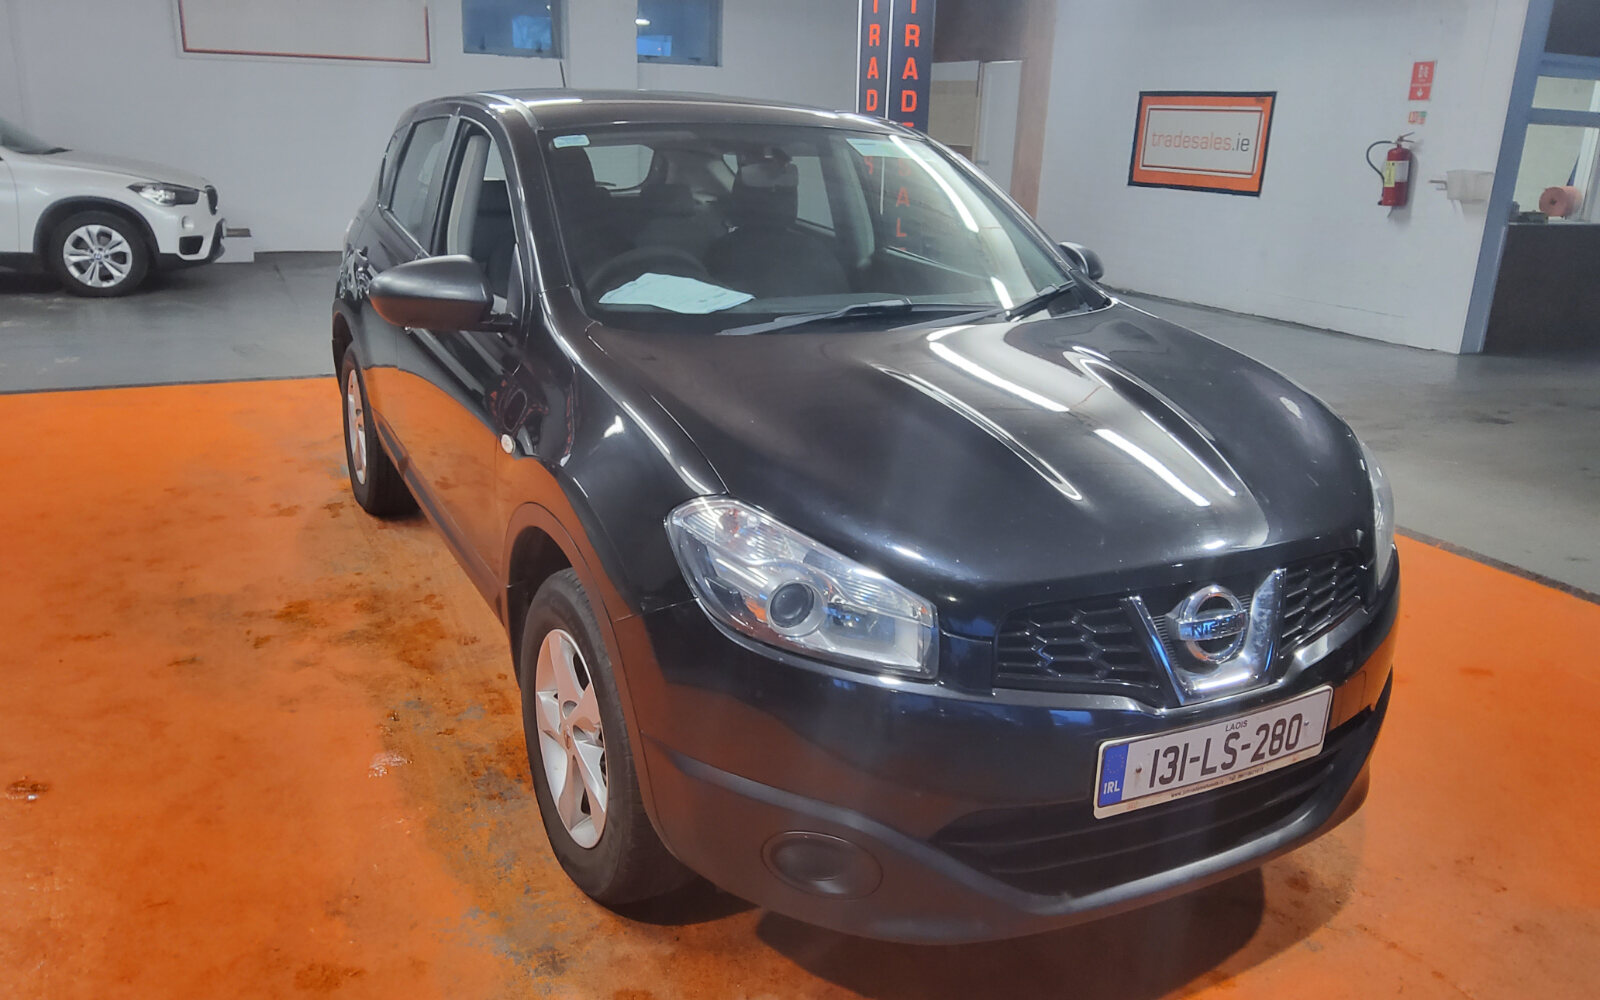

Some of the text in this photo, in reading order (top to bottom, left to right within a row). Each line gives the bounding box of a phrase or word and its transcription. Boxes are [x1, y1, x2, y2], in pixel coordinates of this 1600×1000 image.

[901, 0, 921, 127] RAD
[1151, 130, 1250, 152] tradesales.ie
[895, 157, 911, 250] SAL
[1225, 720, 1248, 732] LAOIS
[1149, 713, 1303, 788] 131-LS-280
[1103, 780, 1121, 795] IRL
